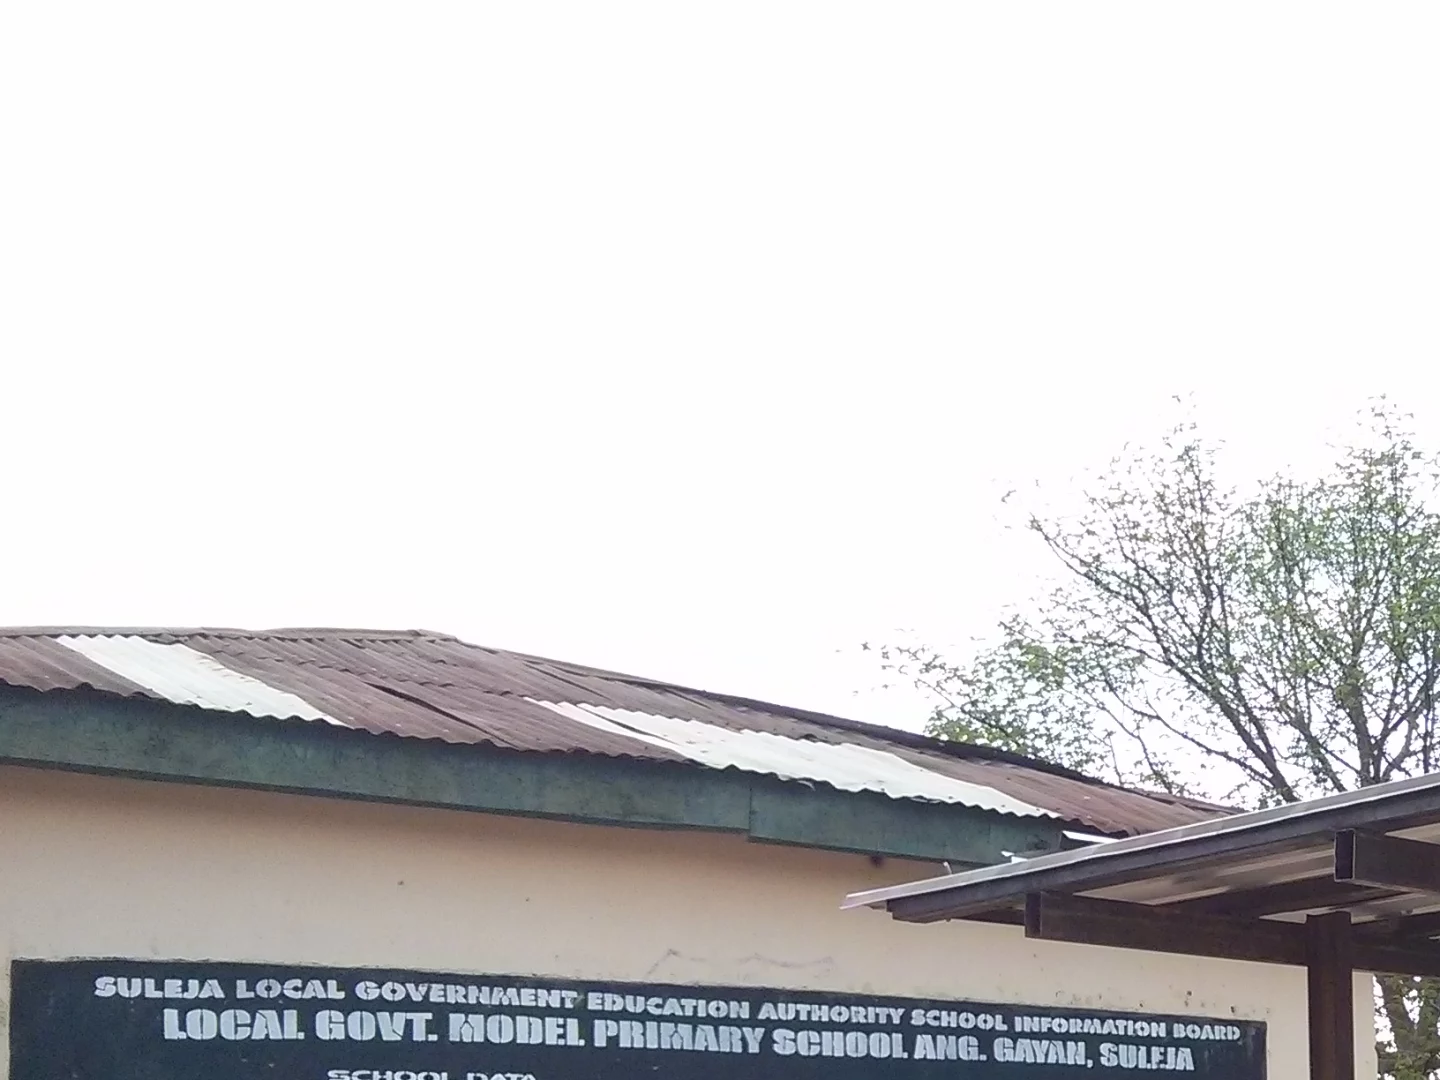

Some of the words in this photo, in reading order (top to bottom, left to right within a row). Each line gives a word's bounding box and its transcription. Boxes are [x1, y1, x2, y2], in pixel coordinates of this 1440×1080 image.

[95, 976, 225, 999] SULEJA
[236, 979, 345, 999] LOCAL
[355, 980, 578, 1009] GOVERNMENT
[587, 992, 749, 1020] EDUCATION
[758, 1002, 905, 1025] AUTHORITY
[910, 1009, 1007, 1031] SCHOOL
[1014, 1016, 1166, 1038] INFORMATION
[1173, 1022, 1240, 1041] BOARD
[163, 1008, 305, 1040] LOCAL
[315, 1009, 438, 1041] GOVT.
[449, 1013, 585, 1046] MODEL
[593, 1019, 765, 1053] PRIMARY
[771, 1028, 908, 1058] SCHOOL
[914, 1034, 987, 1062] ANG.
[993, 1038, 1093, 1068] GAYAN,
[1100, 1043, 1194, 1070] SULEJA
